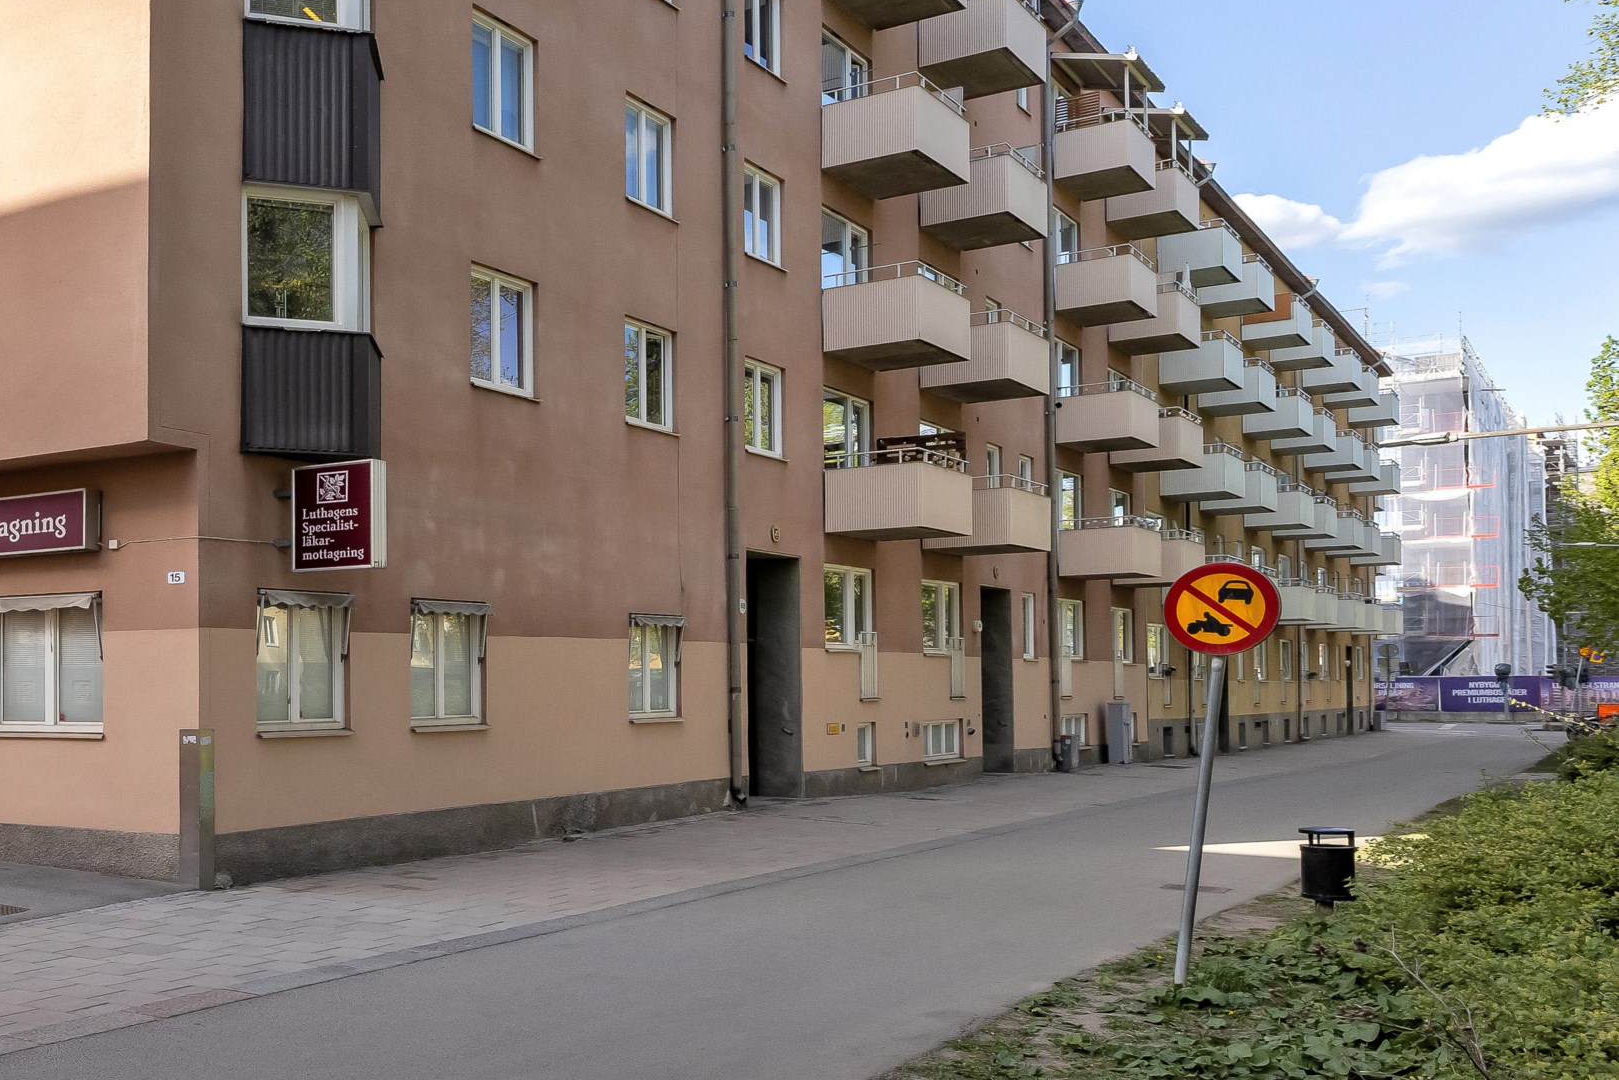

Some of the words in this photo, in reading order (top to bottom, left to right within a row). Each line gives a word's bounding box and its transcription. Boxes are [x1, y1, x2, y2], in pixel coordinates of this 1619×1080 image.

[302, 507, 358, 520] Luthagens
[302, 519, 359, 535] Specialist-
[302, 535, 335, 547] läkar-
[302, 546, 364, 561] mottagning
[170, 572, 181, 582] 15
[1452, 687, 1527, 696] PREMIUMBOSÄDER
